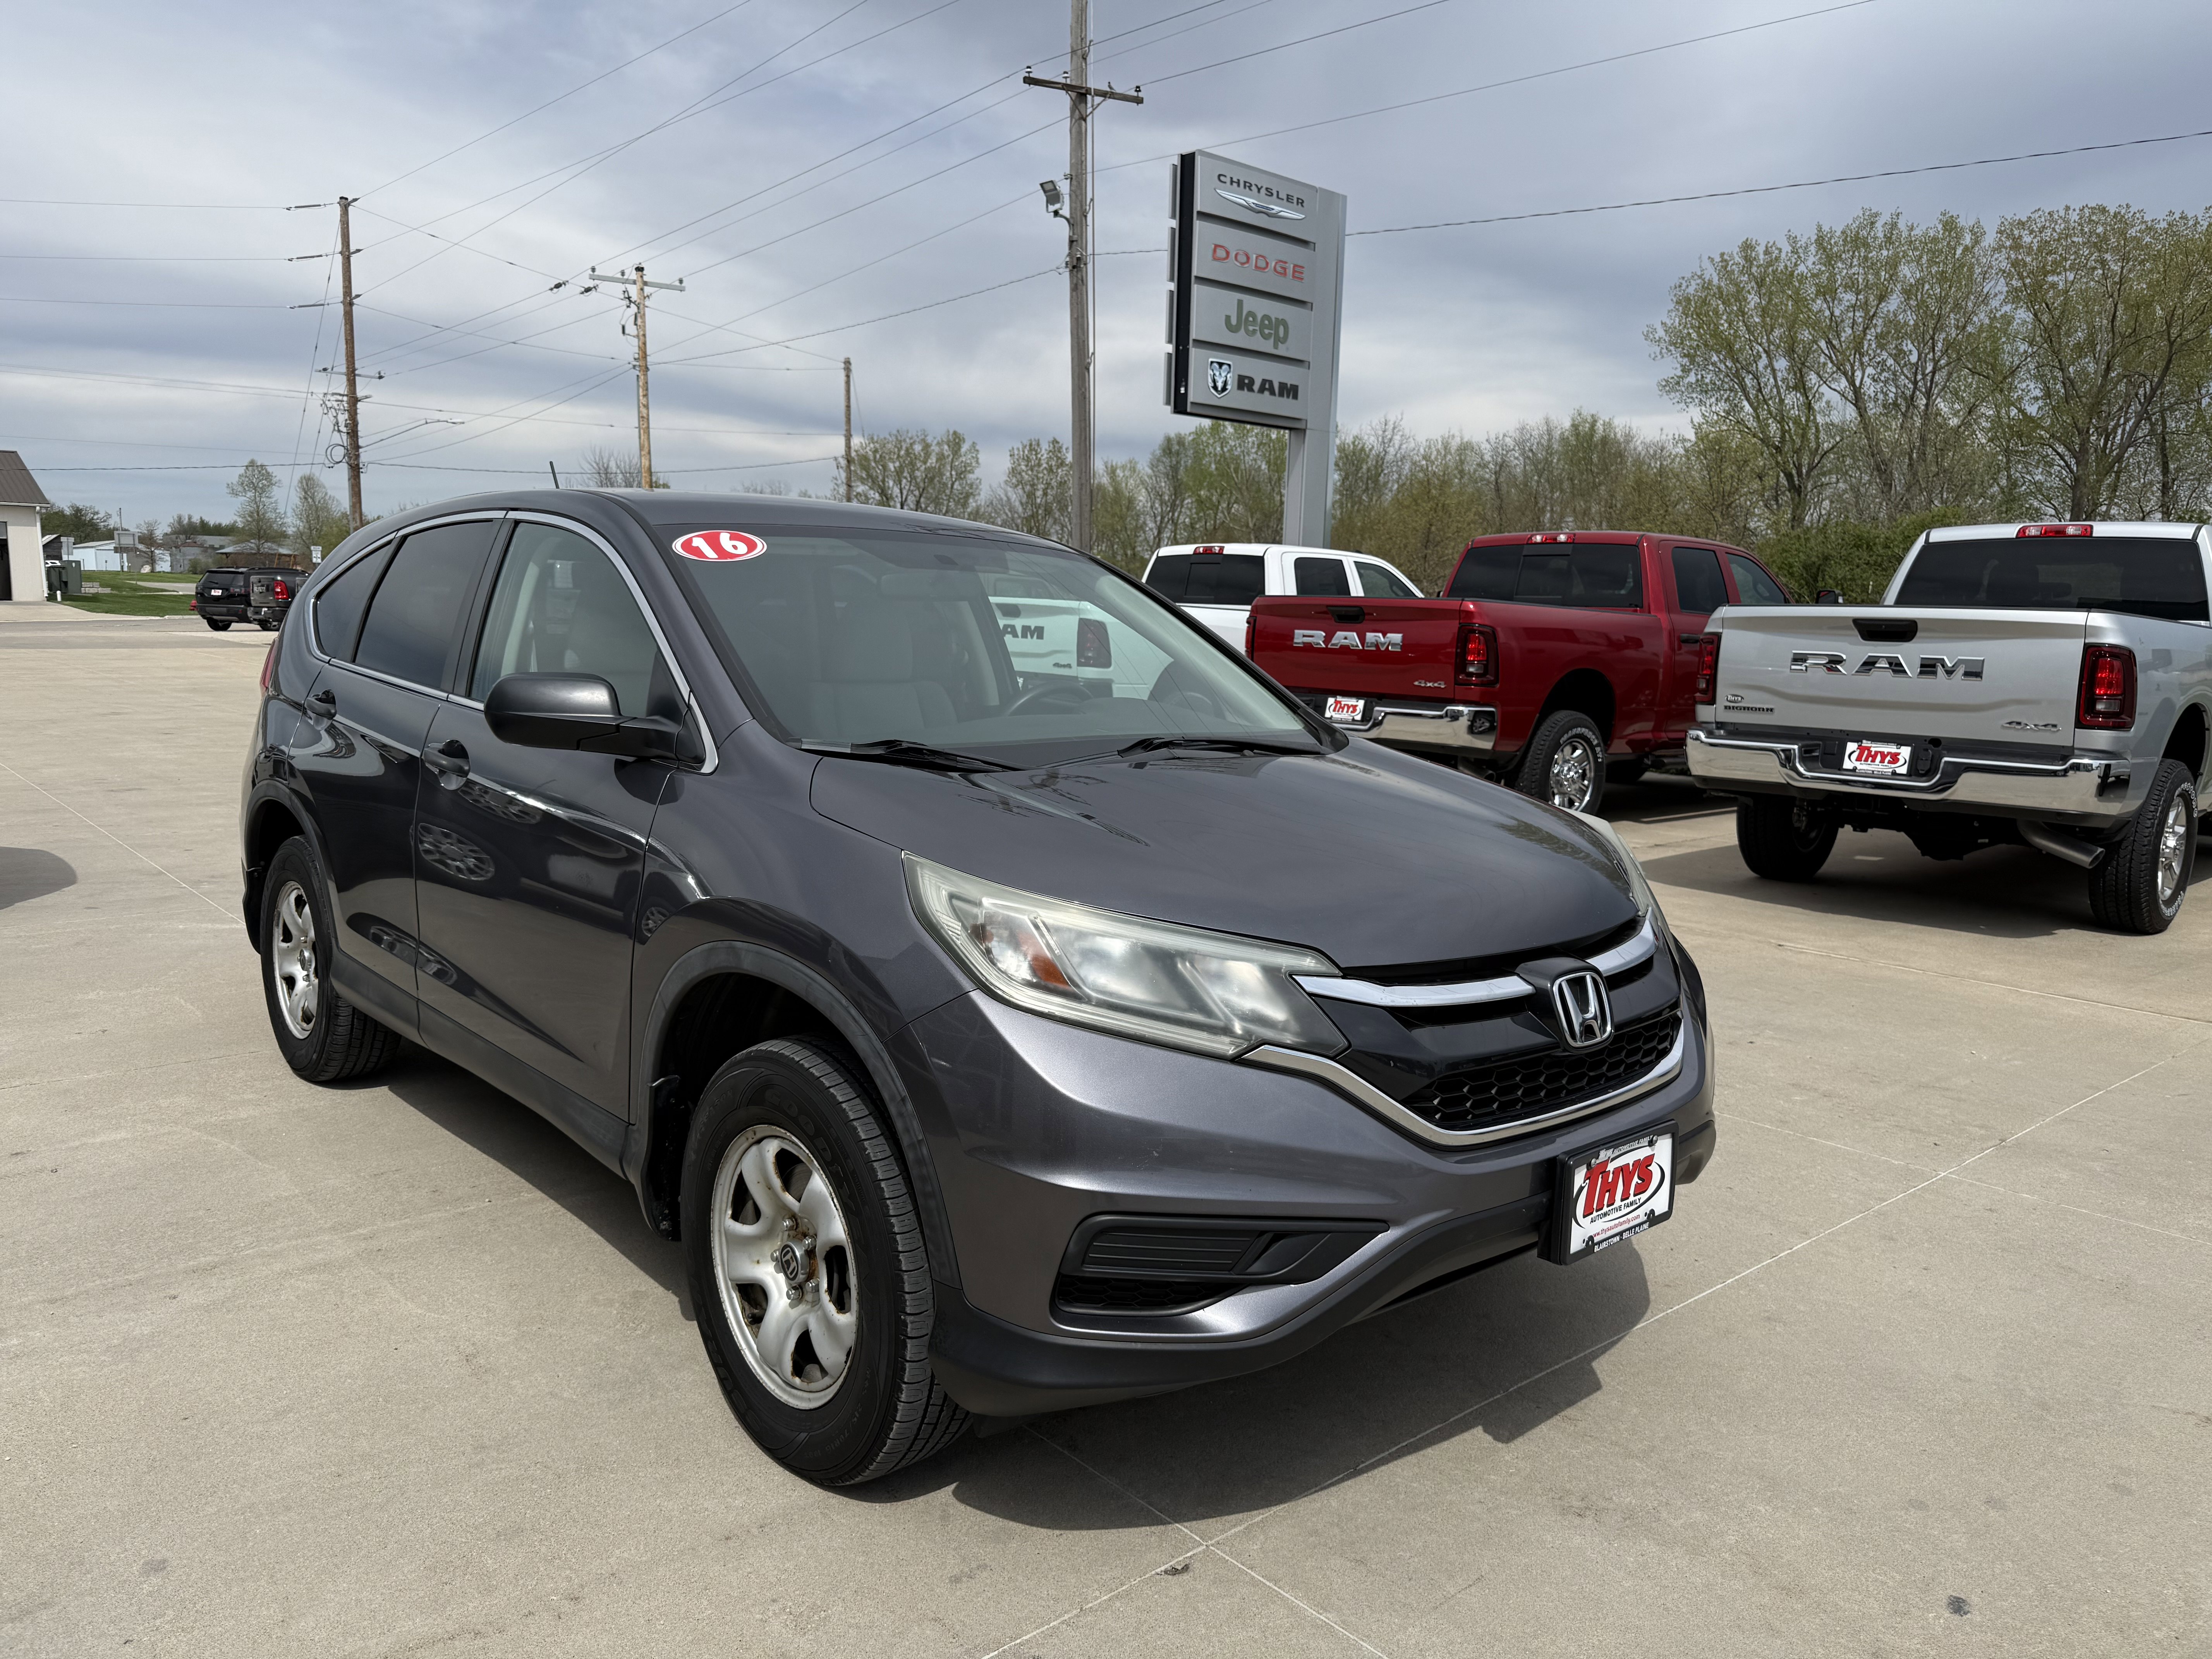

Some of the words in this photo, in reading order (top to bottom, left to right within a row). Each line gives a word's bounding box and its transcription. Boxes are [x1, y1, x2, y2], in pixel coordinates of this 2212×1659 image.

[1217, 173, 1305, 208] CHRYSLER
[1211, 243, 1305, 282] DODGE
[1224, 299, 1289, 349] Jeep
[1237, 374, 1299, 400] RAM
[692, 532, 748, 558] 16
[1001, 624, 1044, 640] AM
[1293, 629, 1403, 651] RAM
[1790, 650, 1985, 681] RAM
[1413, 680, 1447, 688] 4x4
[1332, 700, 1358, 714] THYS
[1723, 705, 1775, 713] BIGHORN
[2001, 720, 2062, 732] 4x4
[1855, 745, 1901, 765] THYS
[1613, 1140, 1639, 1154] AUTOMOTIVE
[1583, 1153, 1655, 1218] THYS
[1590, 1205, 1622, 1224] AUTOMOTIVE
[1623, 1197, 1641, 1210] FAMILY
[1593, 1214, 1640, 1238] ww.thysautofamily.com
[1594, 1235, 1620, 1253] BLAIRSTOWN
[1622, 1228, 1635, 1240] BELLE
[1635, 1222, 1649, 1234] PLAINE
